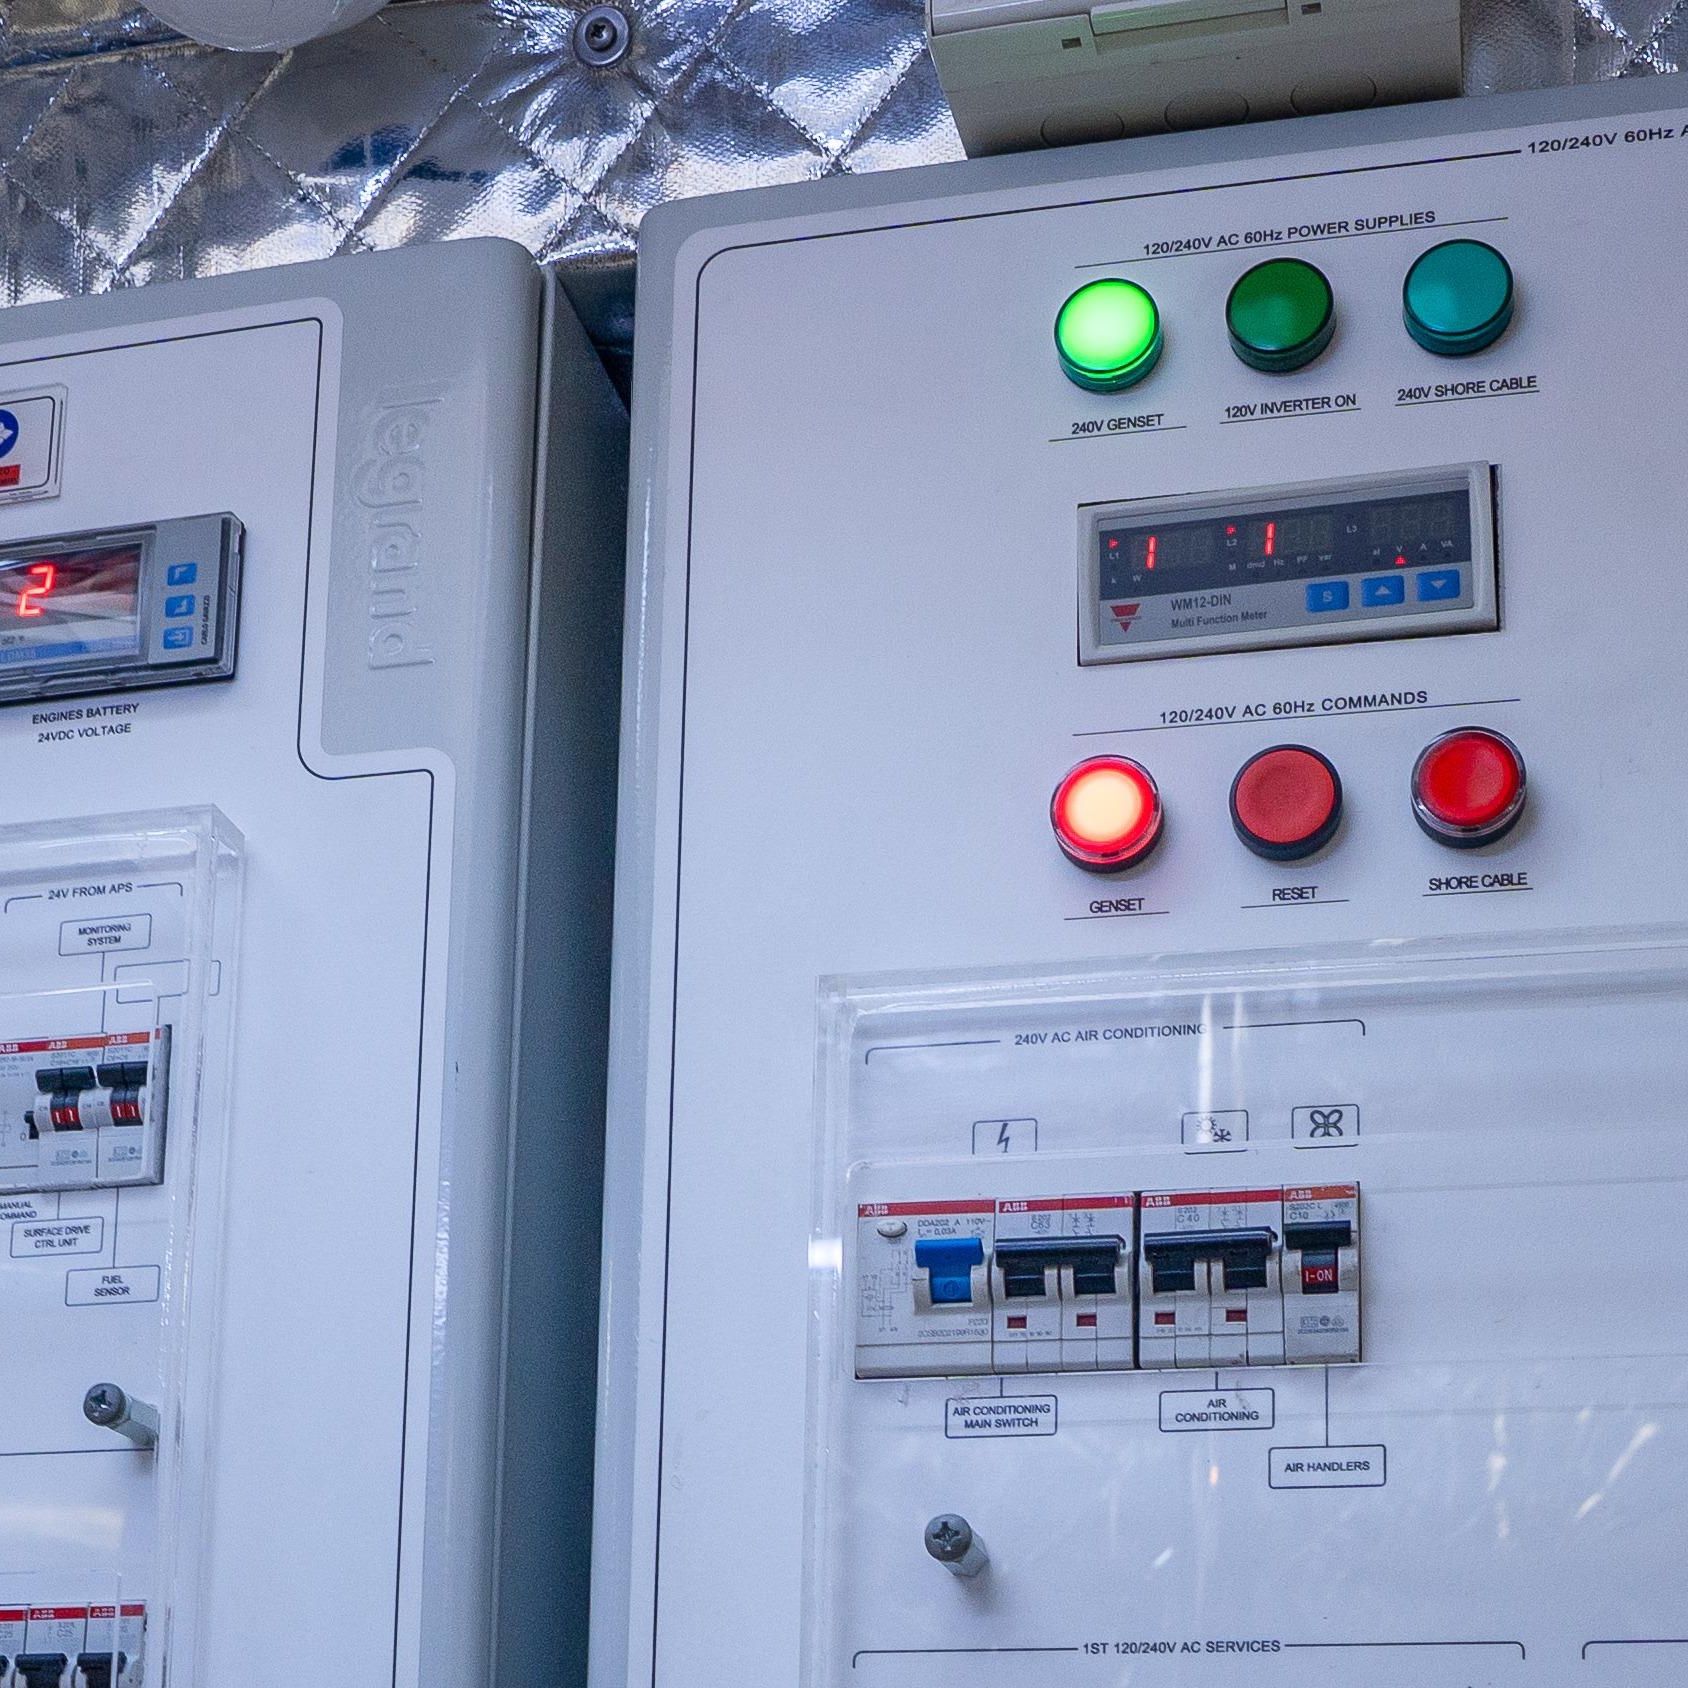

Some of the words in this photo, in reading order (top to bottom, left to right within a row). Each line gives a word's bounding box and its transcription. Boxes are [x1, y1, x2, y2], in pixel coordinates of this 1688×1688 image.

[1528, 133, 1617, 153] 120/240V
[1624, 128, 1674, 143] 60Hz
[1144, 237, 1212, 255] 120/240V
[1217, 234, 1239, 247] AC
[1244, 230, 1283, 244] 60Hz
[1288, 221, 1349, 239] POWER
[1354, 211, 1436, 232] SUPPLIES
[1398, 386, 1431, 401] 240V
[1435, 381, 1486, 397] SHORE
[1489, 375, 1537, 392] CABLE
[1225, 404, 1257, 418] 120V
[1261, 396, 1331, 414] INVERTER
[1335, 394, 1356, 407] ON
[1072, 420, 1104, 434] 240V
[1107, 414, 1164, 430] GENSET
[1171, 594, 1231, 610] WM12-DIN
[1171, 618, 1194, 628] Multi
[1197, 614, 1238, 626] Function
[1241, 611, 1267, 621] Meter
[32, 709, 83, 724] ENGINES
[86, 702, 139, 718] BATTERY
[1160, 706, 1236, 723] 120/240V
[1242, 704, 1266, 717] AC
[1273, 701, 1315, 715] 60Hz
[1321, 690, 1428, 712] COMMANDS
[38, 729, 74, 743] 24VDC
[78, 723, 131, 738] VOLTAGE
[1429, 875, 1479, 891] SHORE
[1481, 872, 1527, 887] CABLE
[48, 889, 69, 900] 24V
[72, 885, 106, 897] FROM
[109, 882, 132, 893] APS
[1273, 886, 1318, 901] RESET
[1090, 898, 1145, 913] GENSET
[78, 924, 131, 935] MONITORING
[88, 936, 121, 946] SYSTEM
[1015, 1033, 1048, 1045] 240V
[1051, 1031, 1071, 1043] AC
[1075, 1030, 1098, 1041] AIR
[1103, 1023, 1208, 1040] CONDITIONING
[1145, 1196, 1171, 1208] ABB
[24, 1227, 63, 1237] SURFACE
[953, 1406, 970, 1416] AIR
[973, 1404, 1050, 1415] CONDITIONING
[964, 1419, 991, 1429] MAIN
[995, 1418, 1038, 1428] SWITCH
[1285, 1463, 1304, 1472] AIR
[1307, 1461, 1370, 1471] HANDLERS
[1084, 1643, 1108, 1654] 1ST
[1114, 1642, 1176, 1654] 120/240V
[1181, 1641, 1201, 1653] AC
[1206, 1640, 1280, 1653] SERVICES
